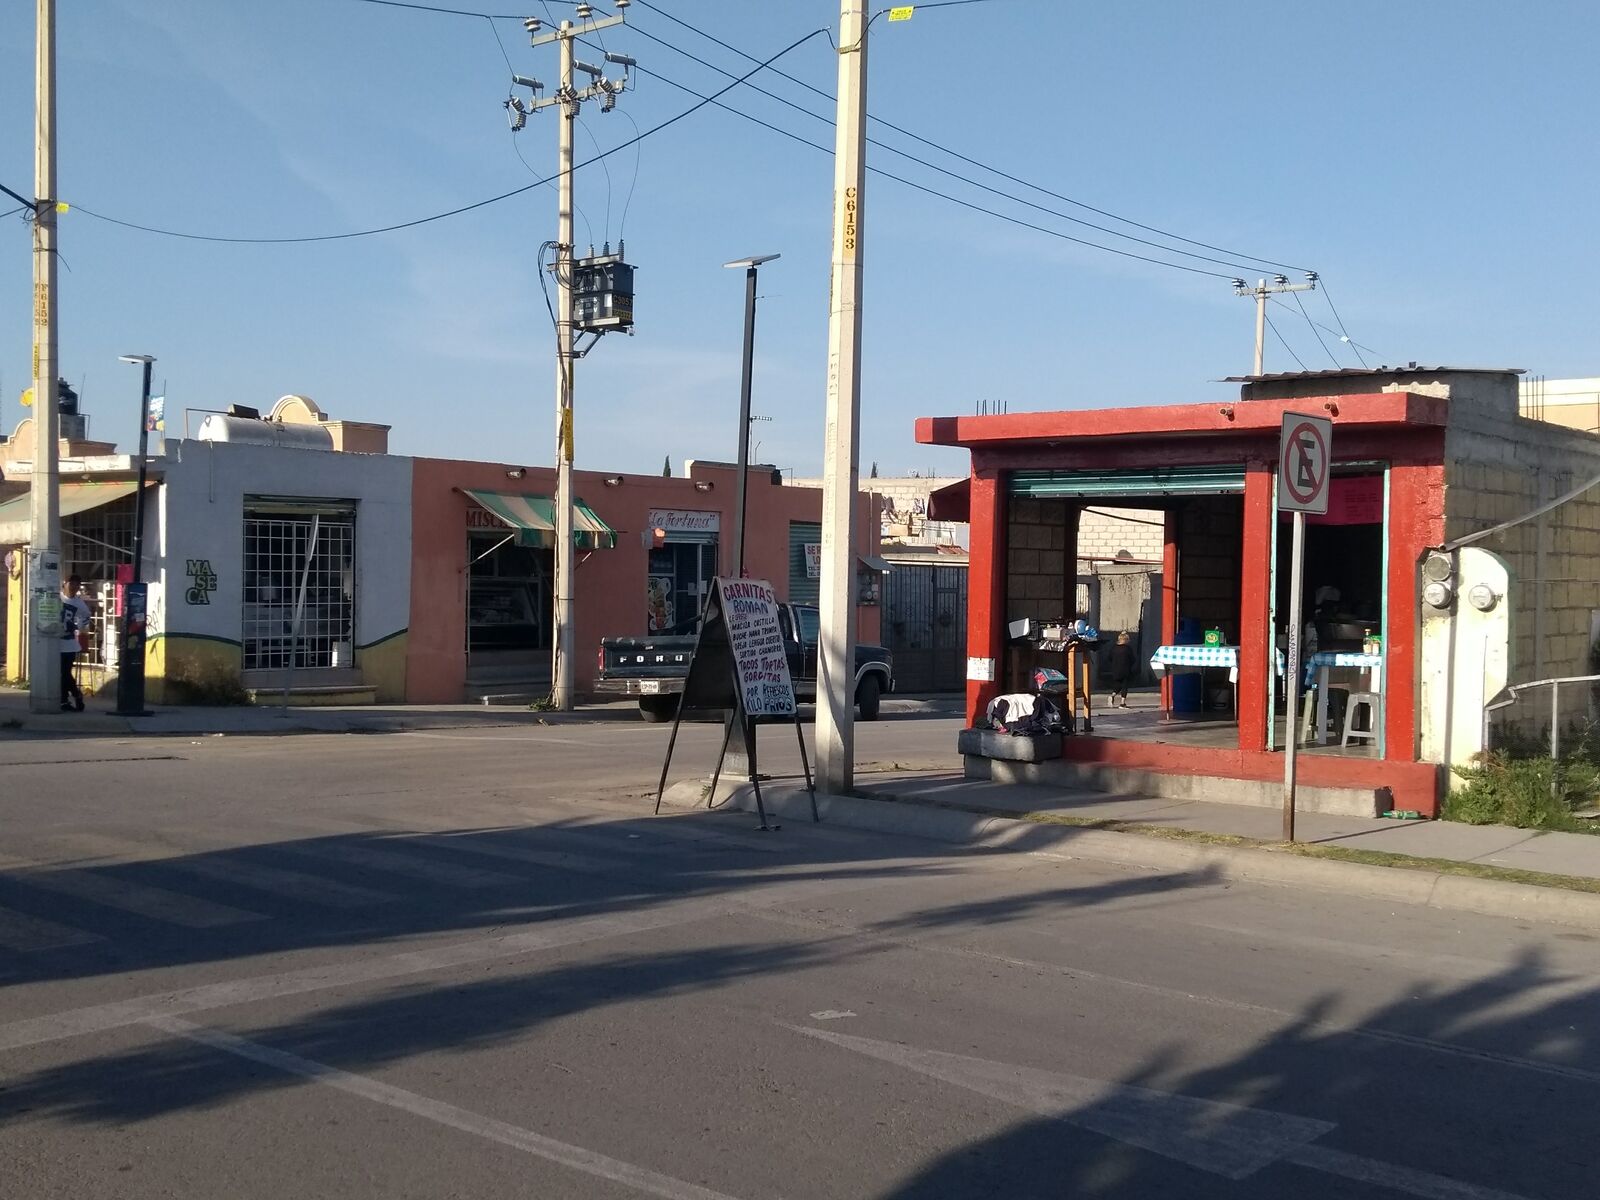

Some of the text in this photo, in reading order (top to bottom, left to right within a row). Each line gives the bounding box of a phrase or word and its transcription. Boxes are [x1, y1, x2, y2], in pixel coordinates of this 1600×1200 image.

[845, 187, 856, 250] C6153
[723, 583, 773, 604] CARNITAS
[733, 599, 769, 615] ROMAN
[761, 656, 785, 672] TORTAS
[746, 685, 759, 697] POR
[746, 697, 792, 713] KILO FRIOS
